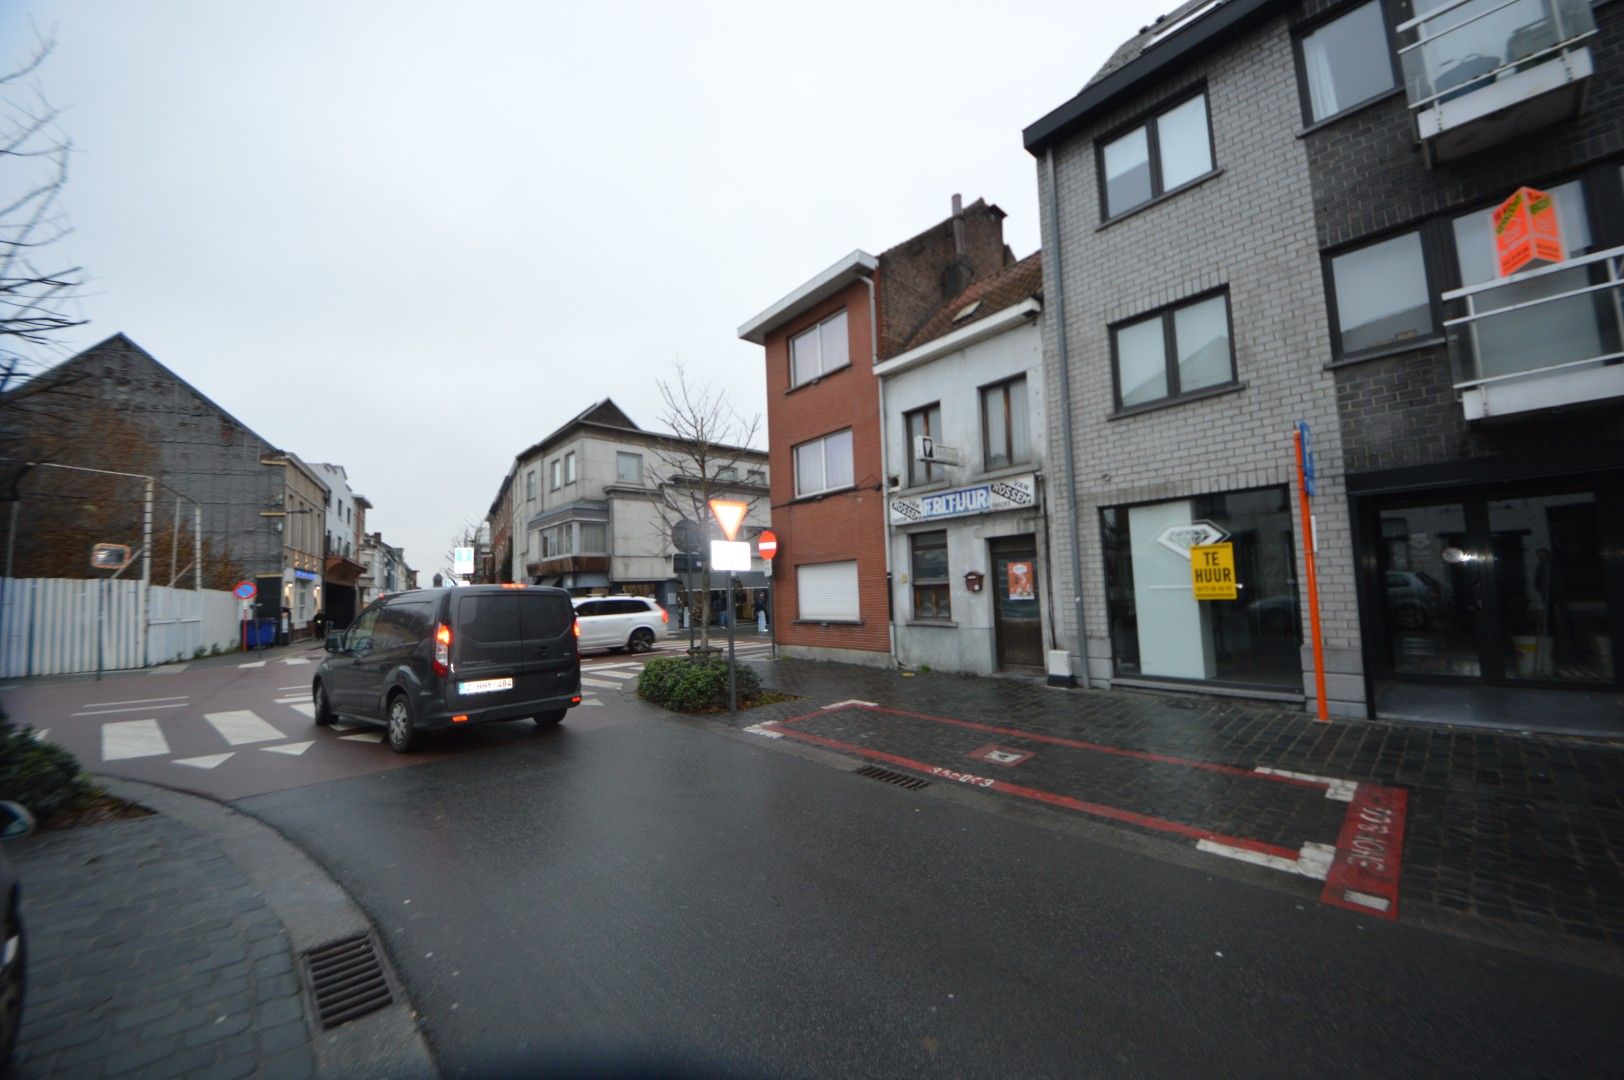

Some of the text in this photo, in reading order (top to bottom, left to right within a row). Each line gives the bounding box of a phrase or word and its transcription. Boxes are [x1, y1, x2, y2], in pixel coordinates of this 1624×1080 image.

[992, 483, 1032, 504] ROSSEM
[1014, 480, 1029, 491] VAN
[893, 501, 921, 520] ROSSEM
[1203, 551, 1220, 566] TE
[1195, 567, 1231, 583] HUUR
